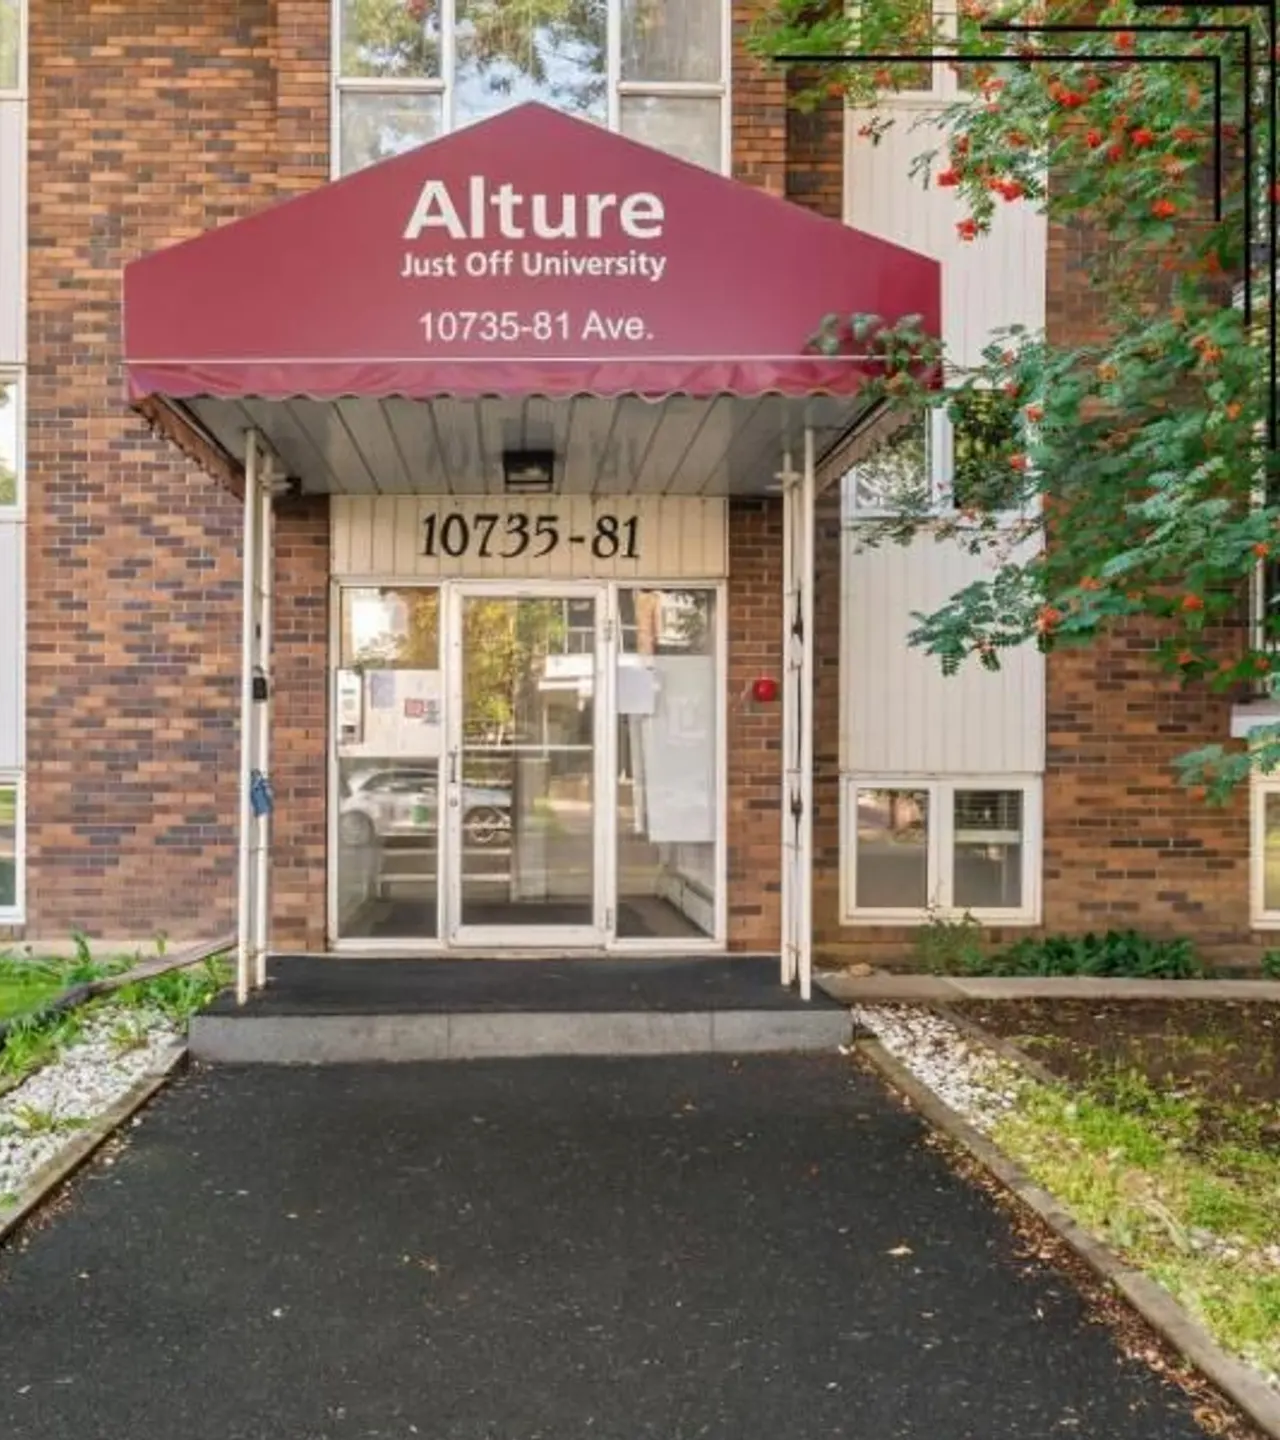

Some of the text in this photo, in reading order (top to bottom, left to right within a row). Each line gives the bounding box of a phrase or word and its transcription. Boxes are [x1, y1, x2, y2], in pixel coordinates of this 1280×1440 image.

[402, 175, 666, 239] Alture
[400, 250, 668, 282] Just Off University
[419, 311, 655, 342] 10735-81 Ave.
[420, 512, 641, 559] 10735-81
